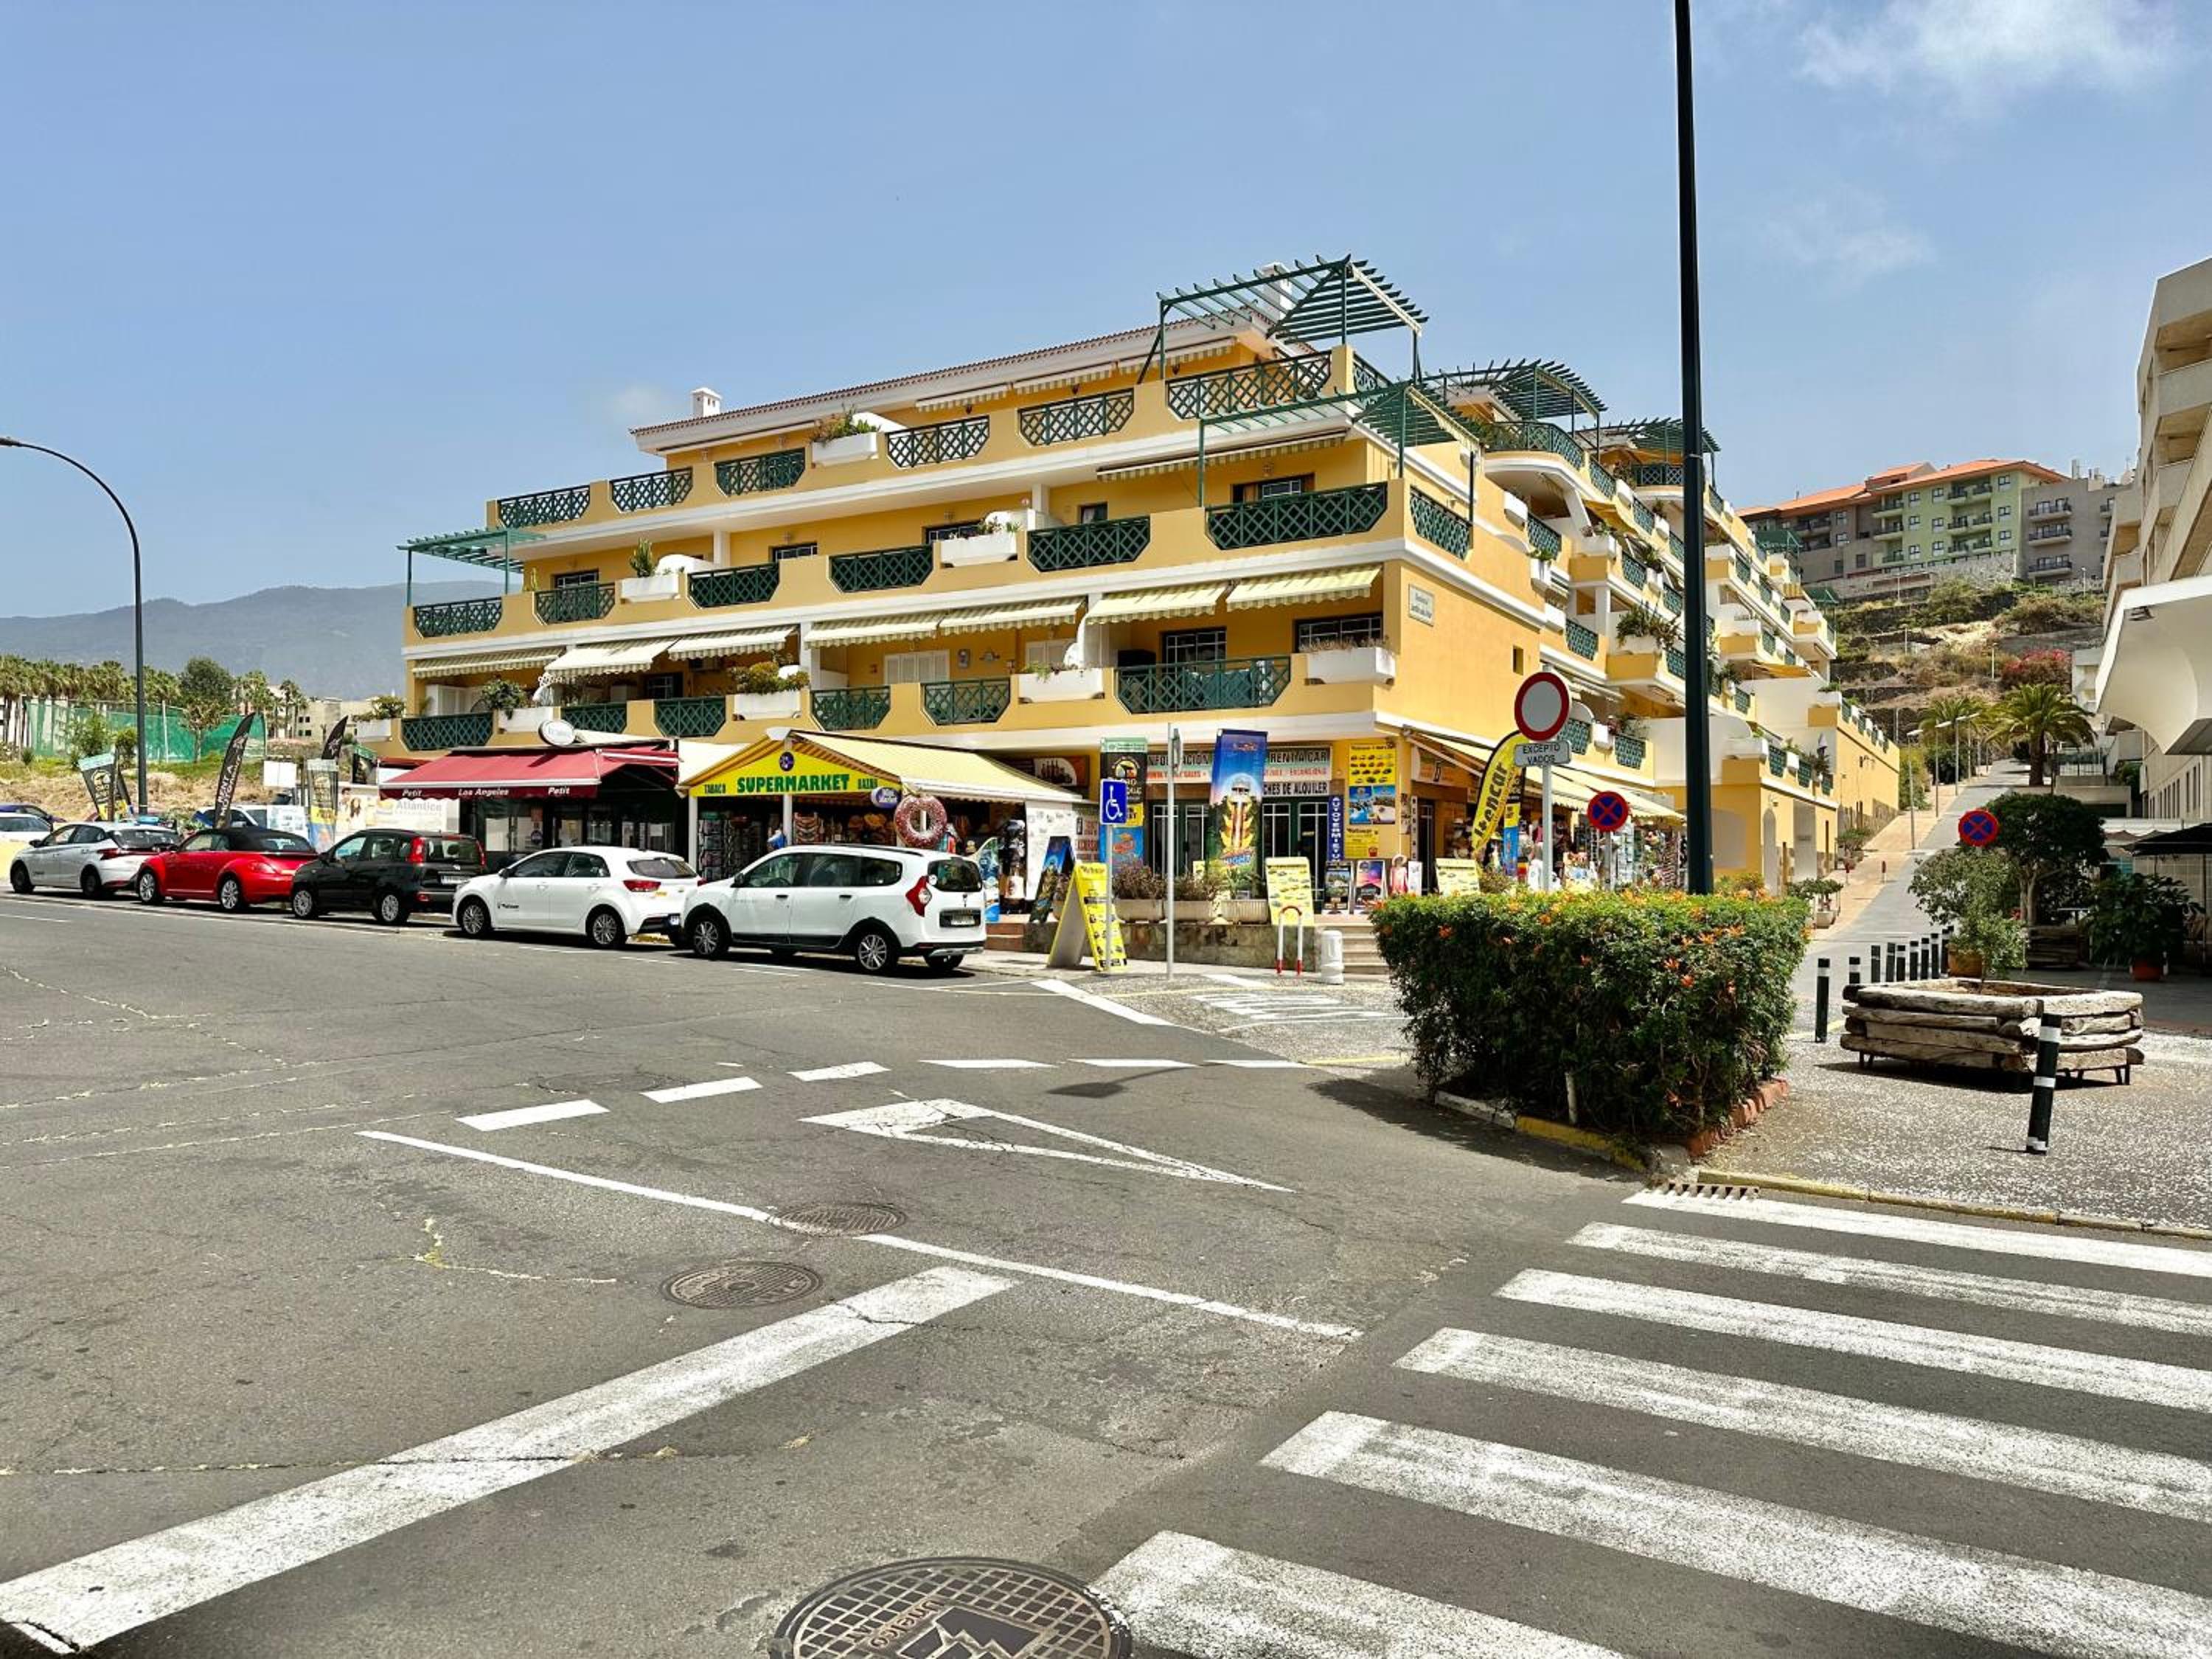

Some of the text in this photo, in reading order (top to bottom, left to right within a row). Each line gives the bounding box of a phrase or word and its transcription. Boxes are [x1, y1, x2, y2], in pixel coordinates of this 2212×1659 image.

[1523, 743, 1560, 754] EXCEPTO
[1270, 751, 1297, 764] RENT
[1307, 751, 1327, 762] CAR
[1527, 754, 1556, 765] VADOS
[737, 773, 850, 793] SUPERMARKET
[1263, 782, 1281, 796] CHES
[1293, 782, 1328, 795] ALQUILER
[458, 788, 509, 797] Los Angeles
[548, 786, 571, 795] Petit
[1331, 797, 1341, 862] AUTOVERMIETU
